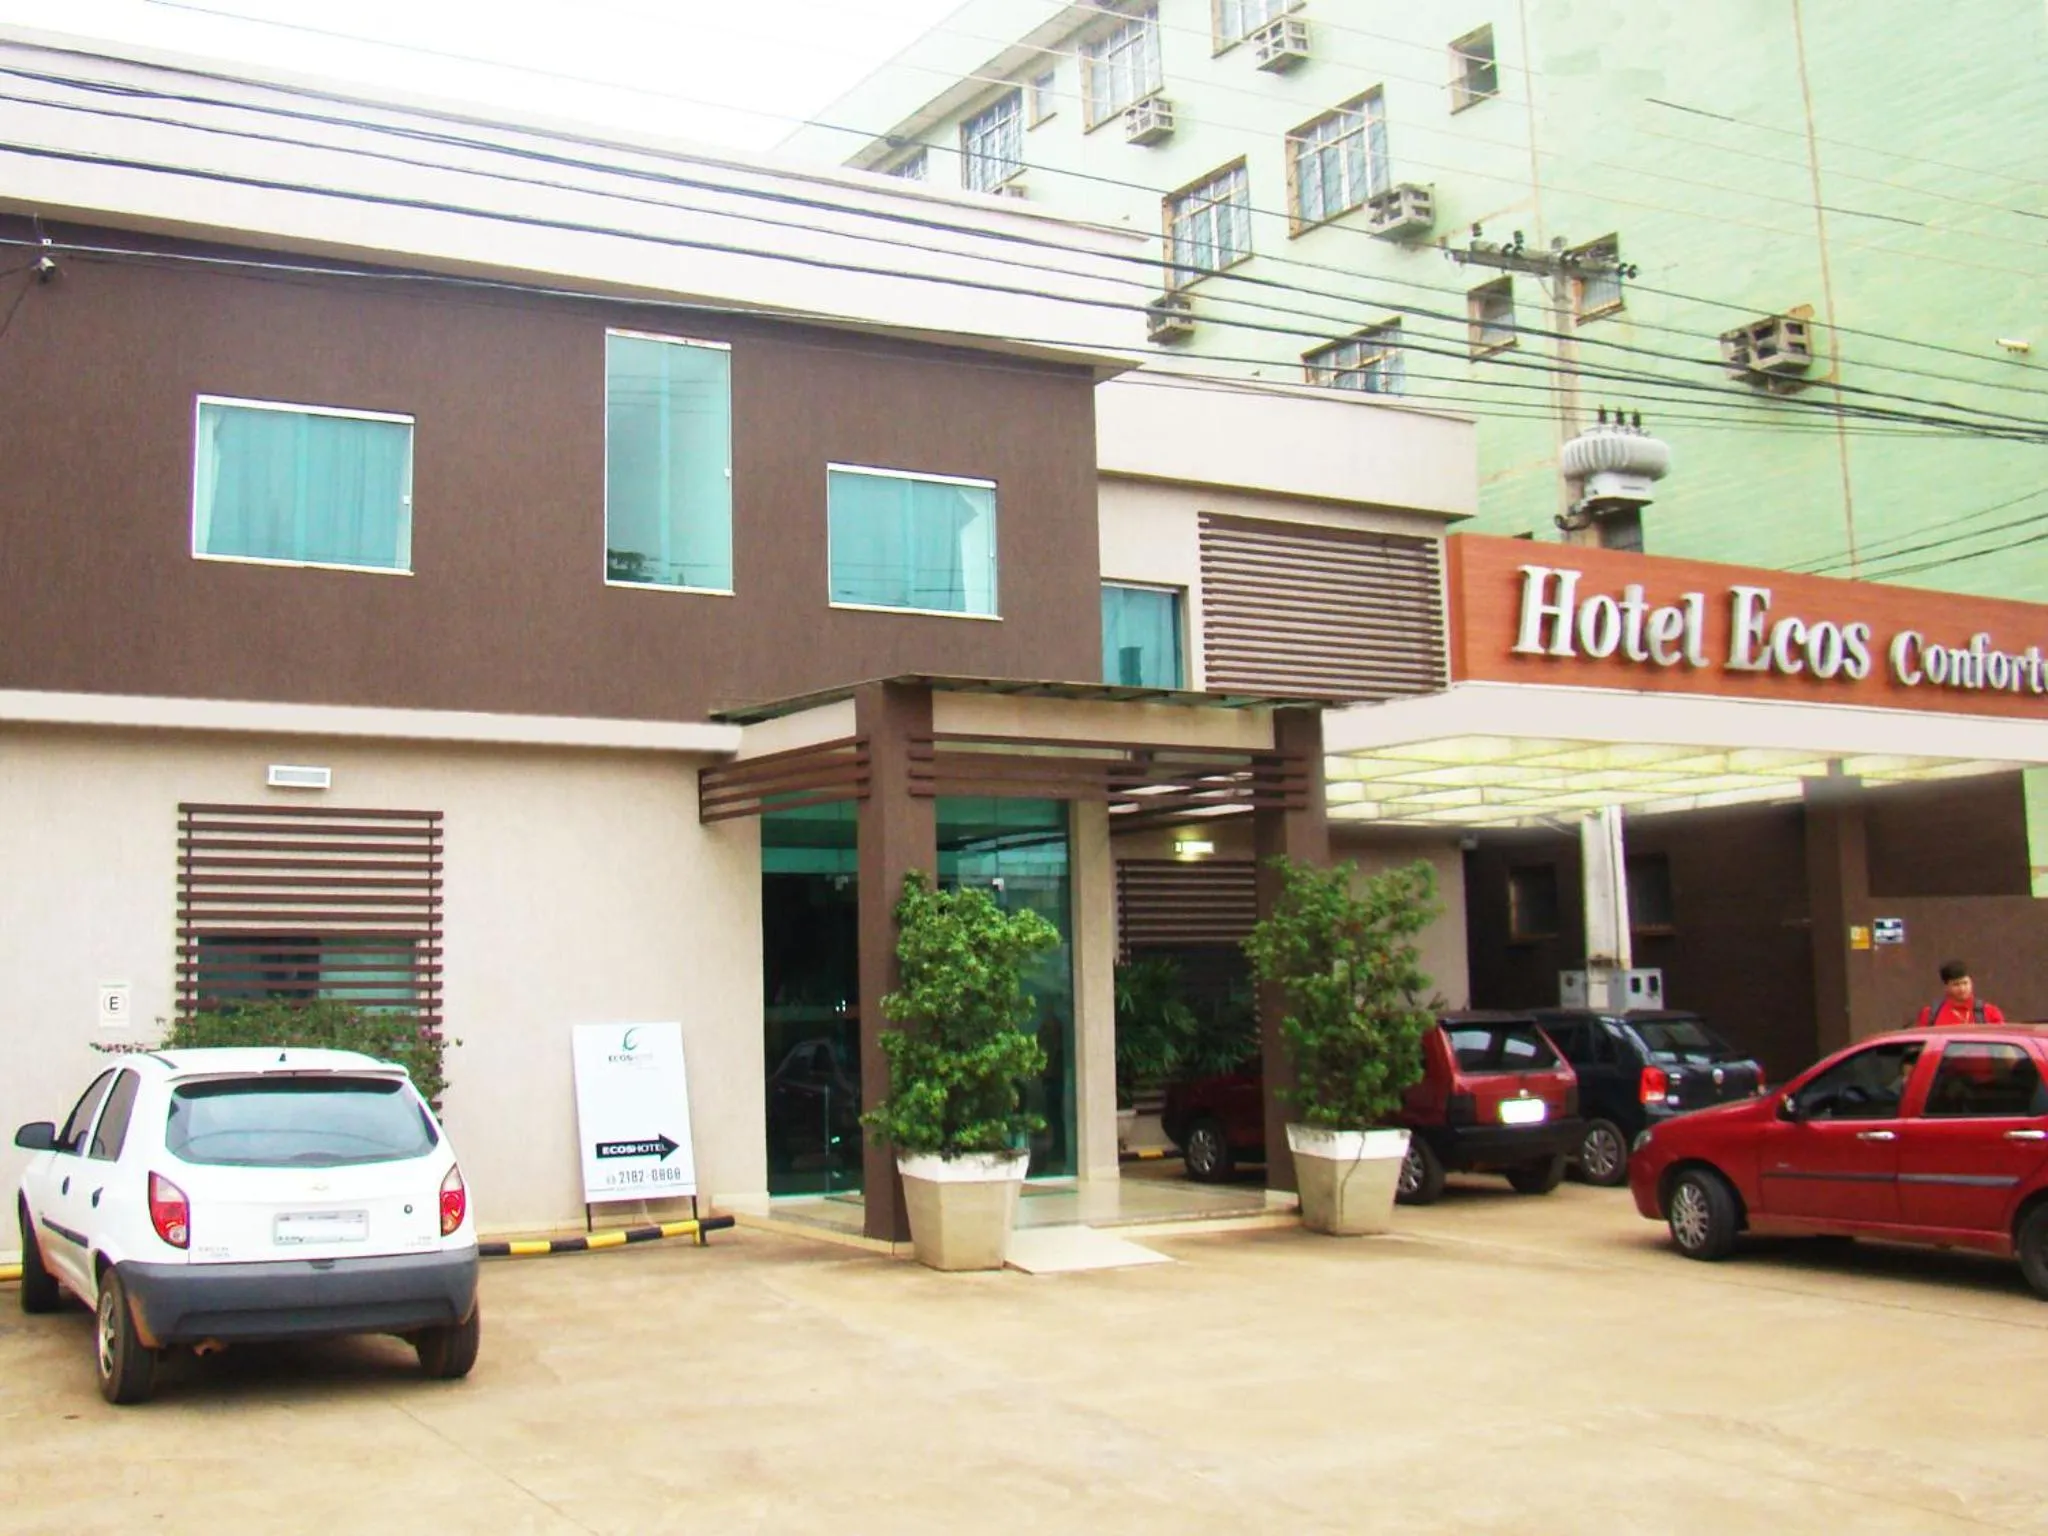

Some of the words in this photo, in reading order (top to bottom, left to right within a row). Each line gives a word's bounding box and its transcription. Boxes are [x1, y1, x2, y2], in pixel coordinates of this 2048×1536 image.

[1512, 564, 1708, 667] Hotel
[1724, 585, 1870, 680] Ecos
[1890, 630, 2048, 694] Confort
[109, 996, 120, 1010] E
